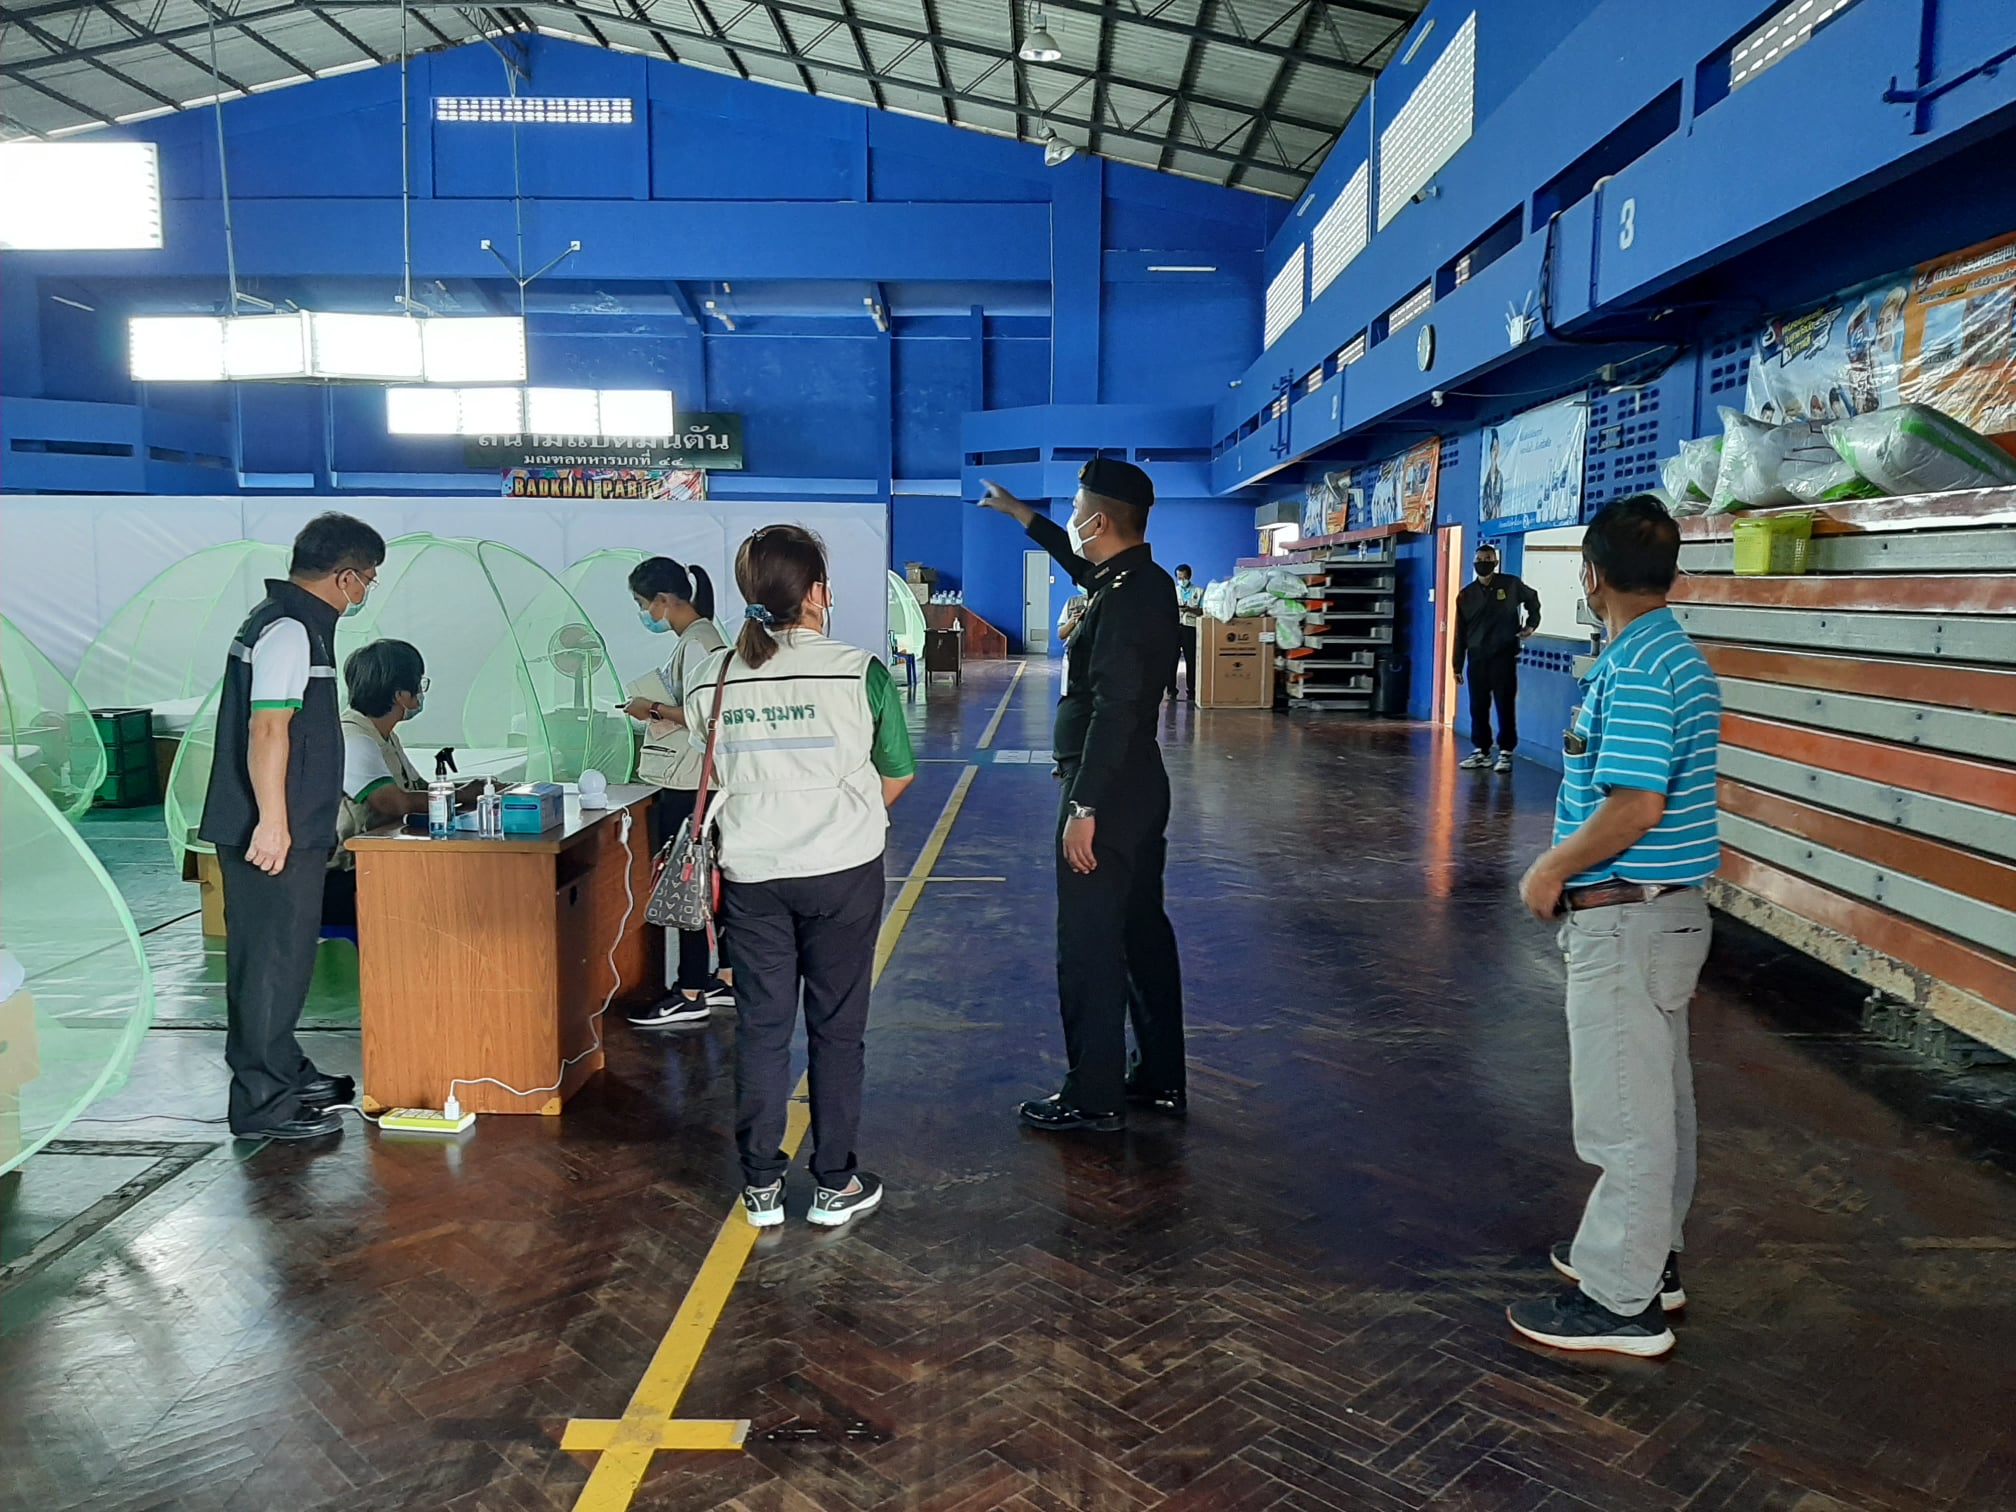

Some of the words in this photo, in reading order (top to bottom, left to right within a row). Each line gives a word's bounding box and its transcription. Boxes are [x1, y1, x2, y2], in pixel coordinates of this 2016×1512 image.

[1619, 196, 1636, 251] 3
[477, 425, 730, 450] สนามแบดมนตัน
[523, 449, 651, 467] มณฑลทหารบกที่
[658, 456, 684, 467] ๔๔
[513, 477, 593, 498] BADKHAI
[602, 478, 664, 499] PARTY
[722, 708, 760, 725] สสจ.
[762, 704, 816, 730] ชุมพร
